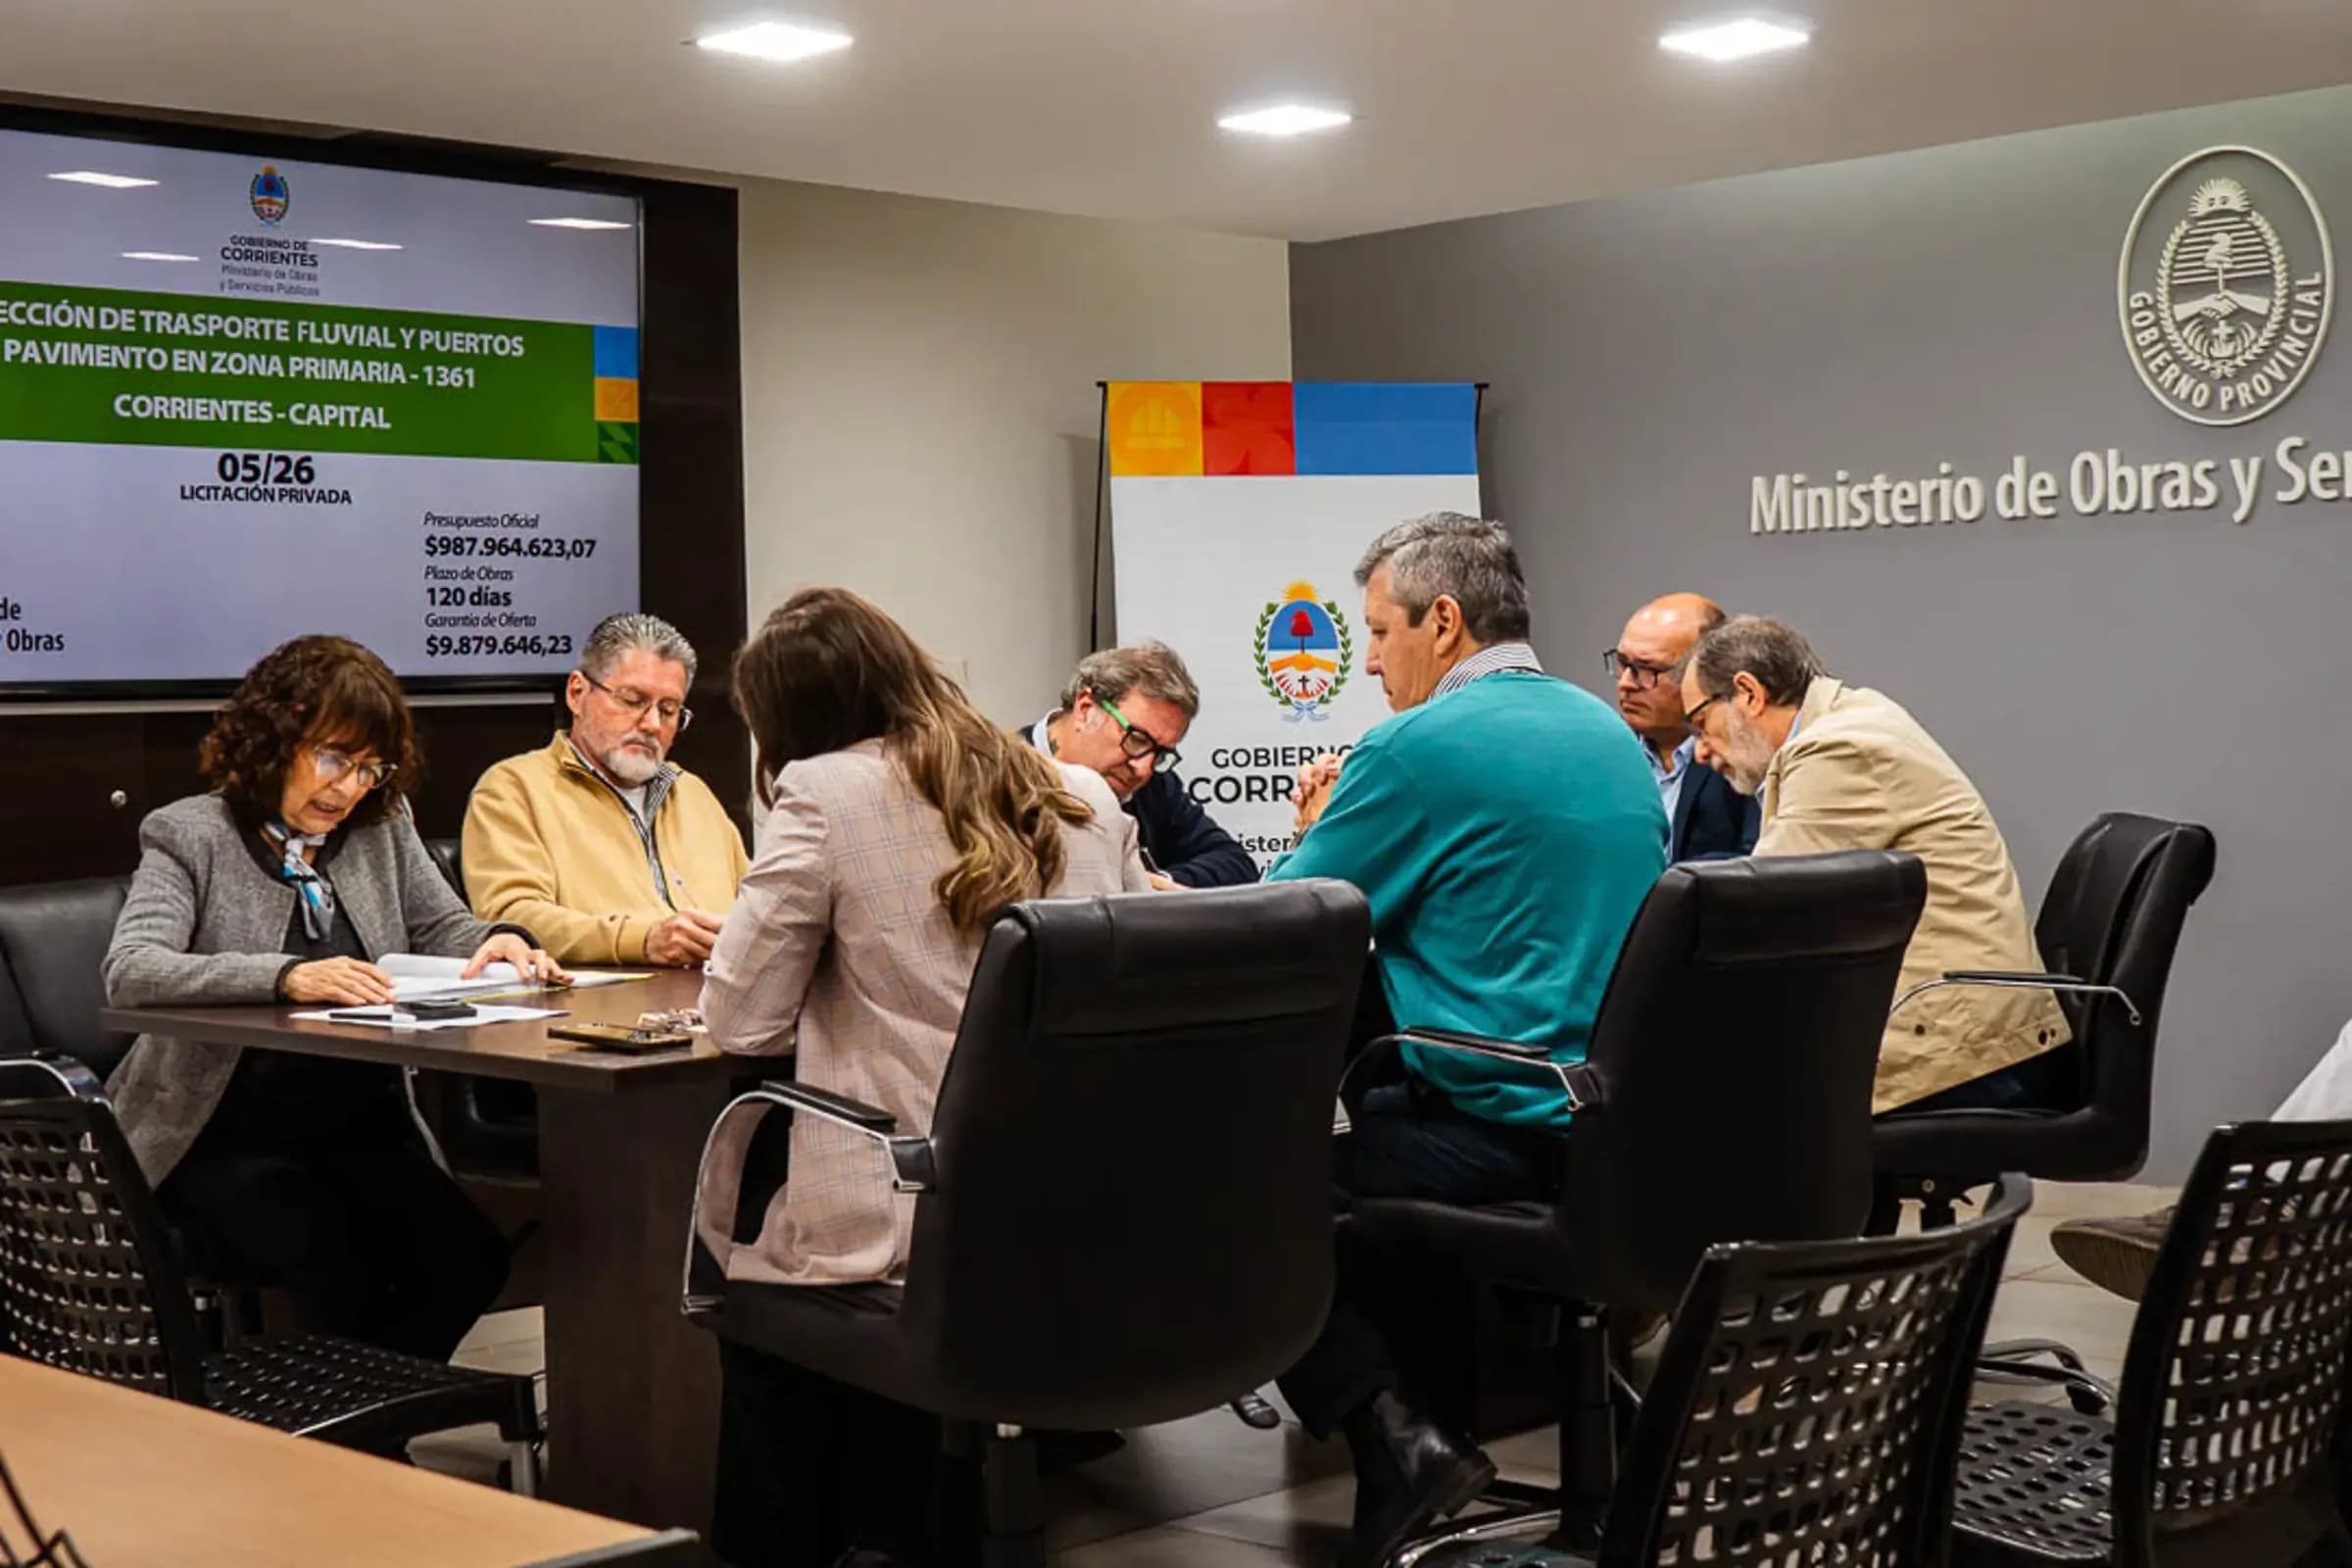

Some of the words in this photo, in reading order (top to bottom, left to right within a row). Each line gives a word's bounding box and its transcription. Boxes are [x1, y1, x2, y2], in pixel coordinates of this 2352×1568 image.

[230, 235, 291, 250] GOBIERNO
[293, 241, 309, 251] DE
[220, 246, 318, 267] CORRIENTES
[99, 307, 136, 331] DE
[139, 310, 290, 341] TRASPORTE
[297, 320, 396, 349] FLUVIAL
[400, 327, 416, 349] Y
[419, 329, 525, 358] PUERTOS
[2129, 291, 2211, 409] GOBIERNO
[2220, 271, 2323, 412] PROVINCIAL
[4, 338, 168, 371] PAVIMENTO
[172, 349, 207, 373] EN
[211, 351, 285, 377] ZONA
[289, 356, 408, 384] PRIMARIA
[423, 365, 475, 388] 1361
[114, 394, 273, 423] CORRIENTES
[288, 402, 392, 429] CAPITAL
[218, 452, 315, 485] 05/26
[180, 484, 275, 503] LICITACIÓN
[278, 488, 352, 505] PRIVADA
[1750, 462, 1986, 534] Ministerio
[1995, 455, 2058, 519] de
[2070, 447, 2219, 514] Obras
[2230, 456, 2263, 523] y
[423, 512, 499, 530] Presupuesto
[501, 514, 539, 529] Oficial
[424, 535, 597, 561] $987.964.623,07
[423, 564, 458, 580] Plazo
[461, 565, 474, 580] de
[477, 565, 514, 580] Obras
[427, 587, 466, 607] 120
[481, 612, 496, 628] de
[498, 612, 537, 628] Oferta
[7, 628, 65, 652] Obras
[425, 635, 573, 658] $9.879.646,23
